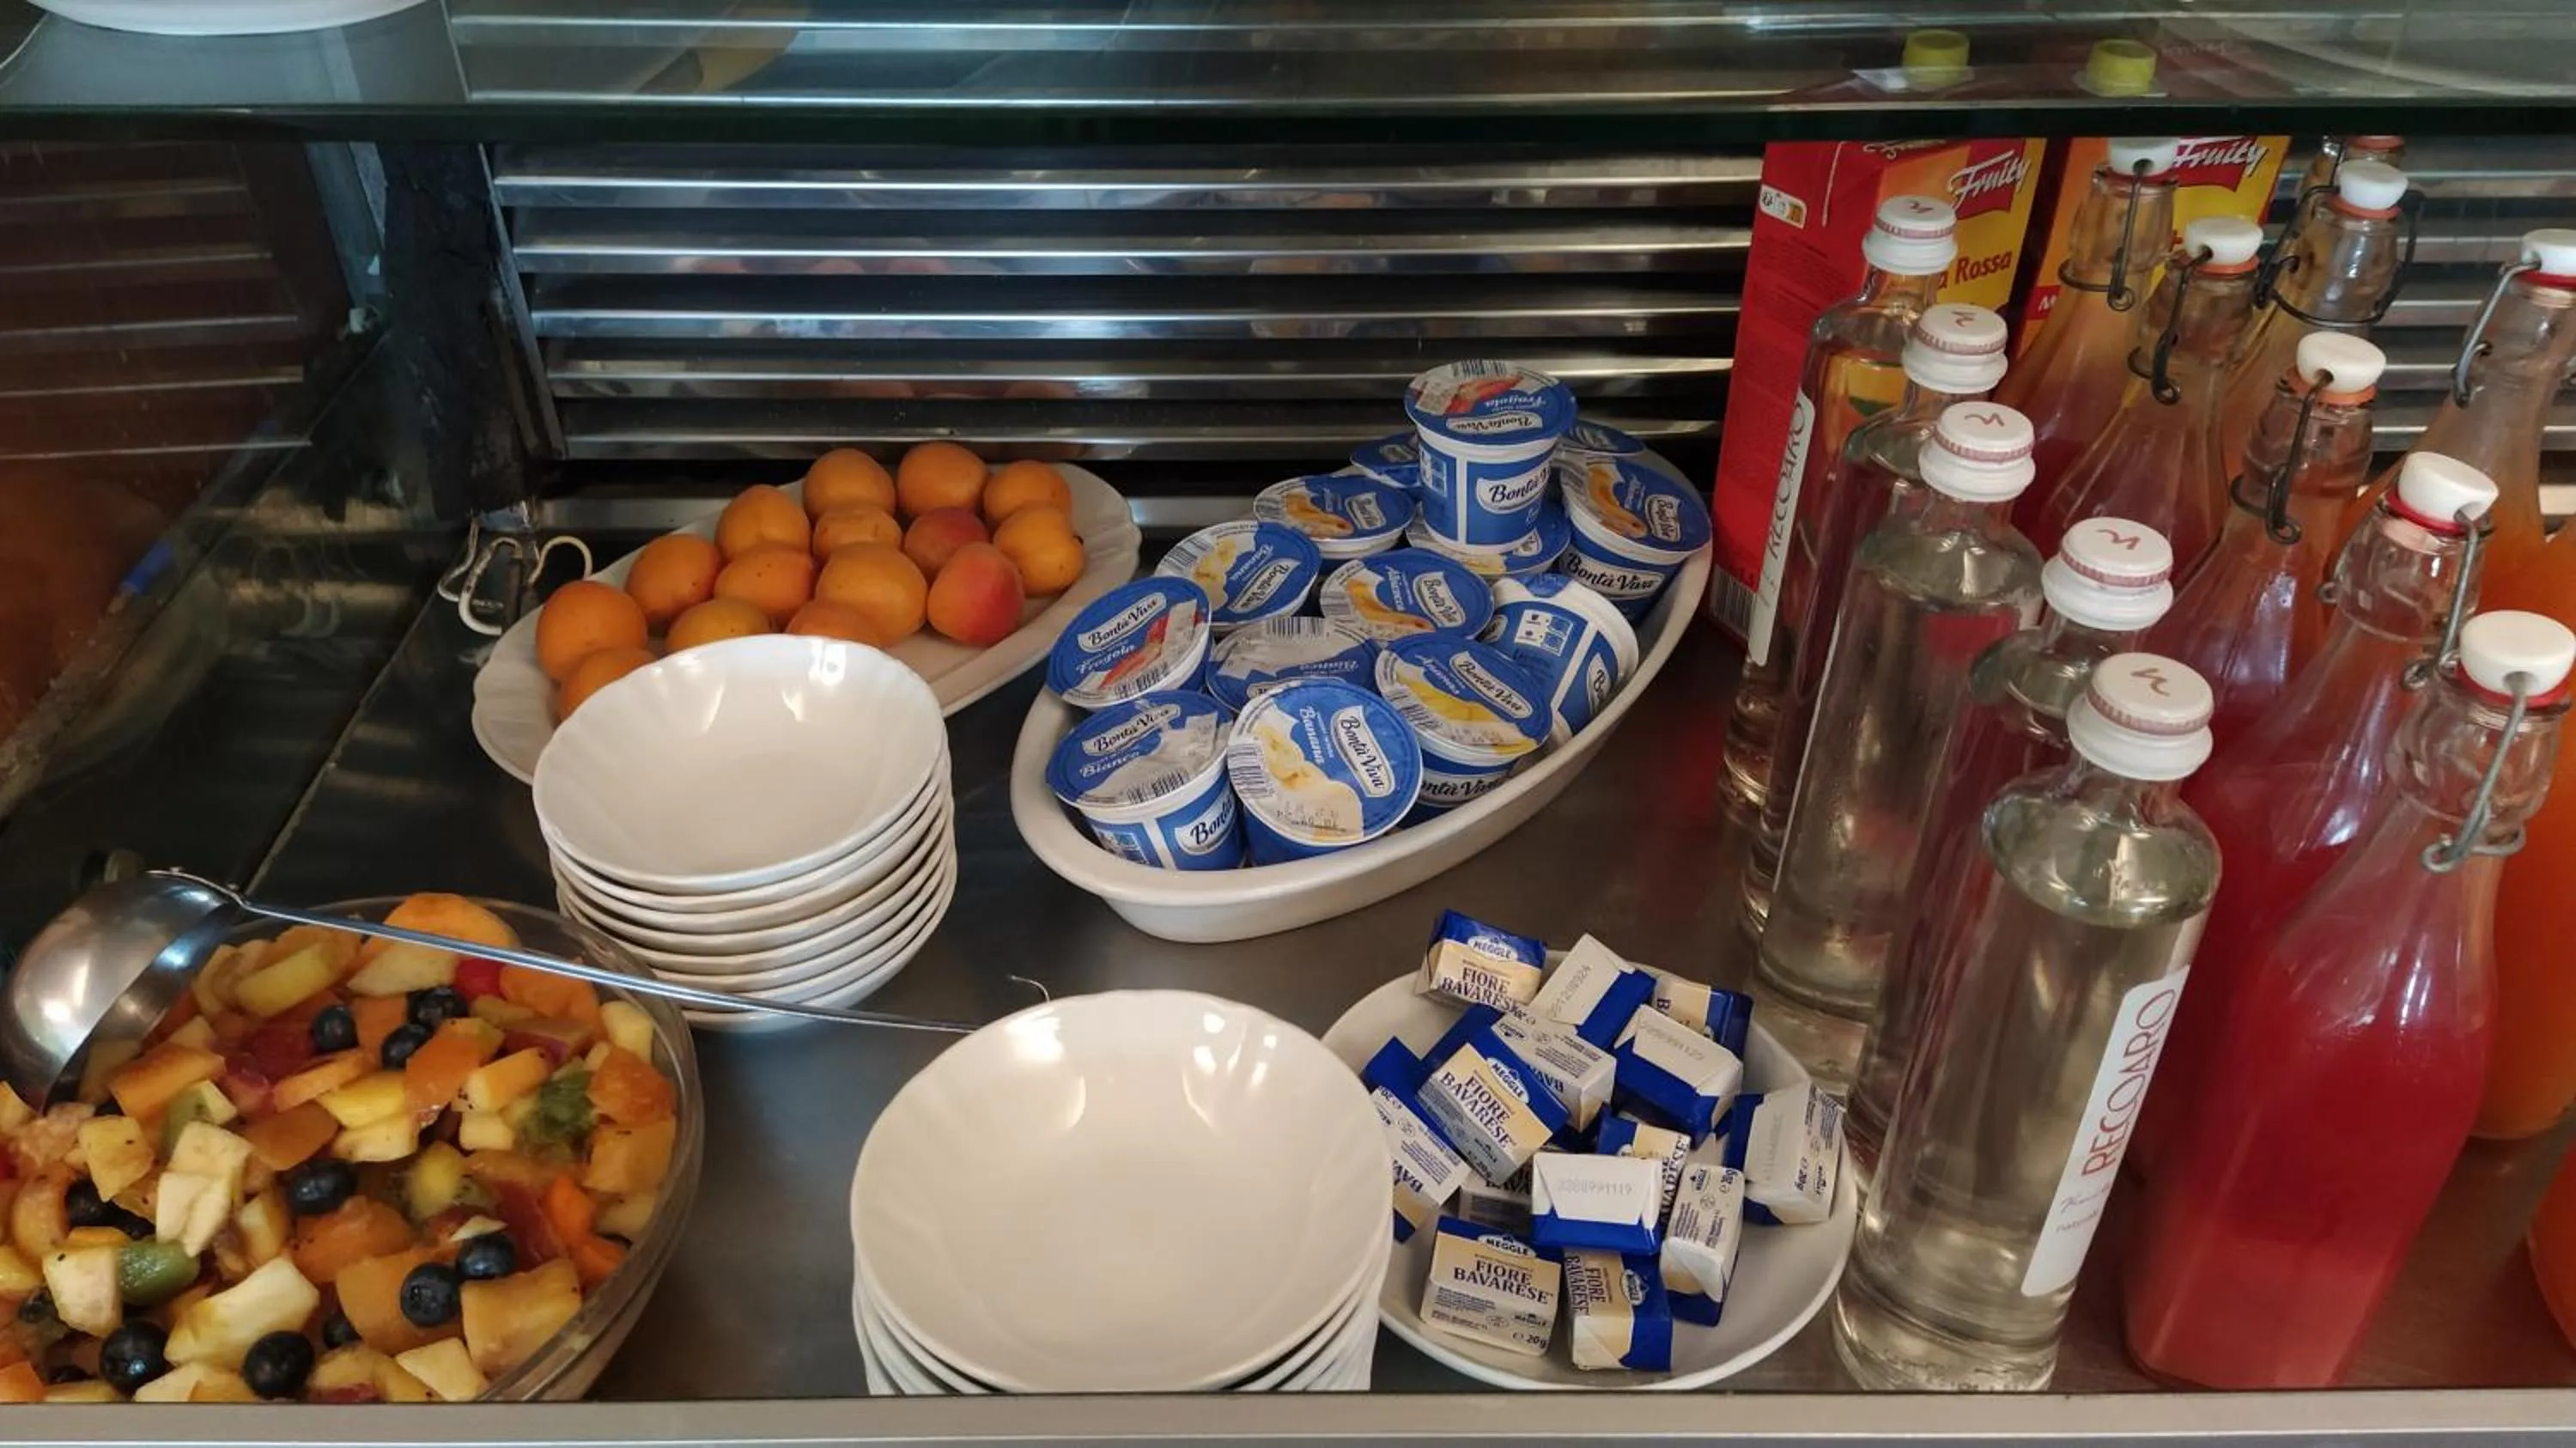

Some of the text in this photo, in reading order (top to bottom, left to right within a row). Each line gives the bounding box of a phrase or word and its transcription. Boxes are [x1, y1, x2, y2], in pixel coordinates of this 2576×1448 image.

[1947, 149, 2031, 211] Fruity
[1954, 250, 2013, 286] Rossa
[1566, 551, 1614, 588] Bontà
[1087, 598, 1159, 647] Bontà Viva
[1093, 708, 1170, 752] Bontà Viva
[1079, 749, 1139, 778] Bianco
[1340, 715, 1385, 788] Bontà Viva
[1461, 966, 1510, 994] FIORE
[1440, 1071, 1513, 1148] BAVARESE
[1465, 1075, 1510, 1124] FIORE
[1485, 1238, 1529, 1256] MEGGLE
[1453, 1267, 1551, 1305] BAVARESE
[1475, 1259, 1533, 1287] FIORE
[1585, 1267, 1607, 1303] FIORE
[1526, 1334, 1547, 1349] 20g
